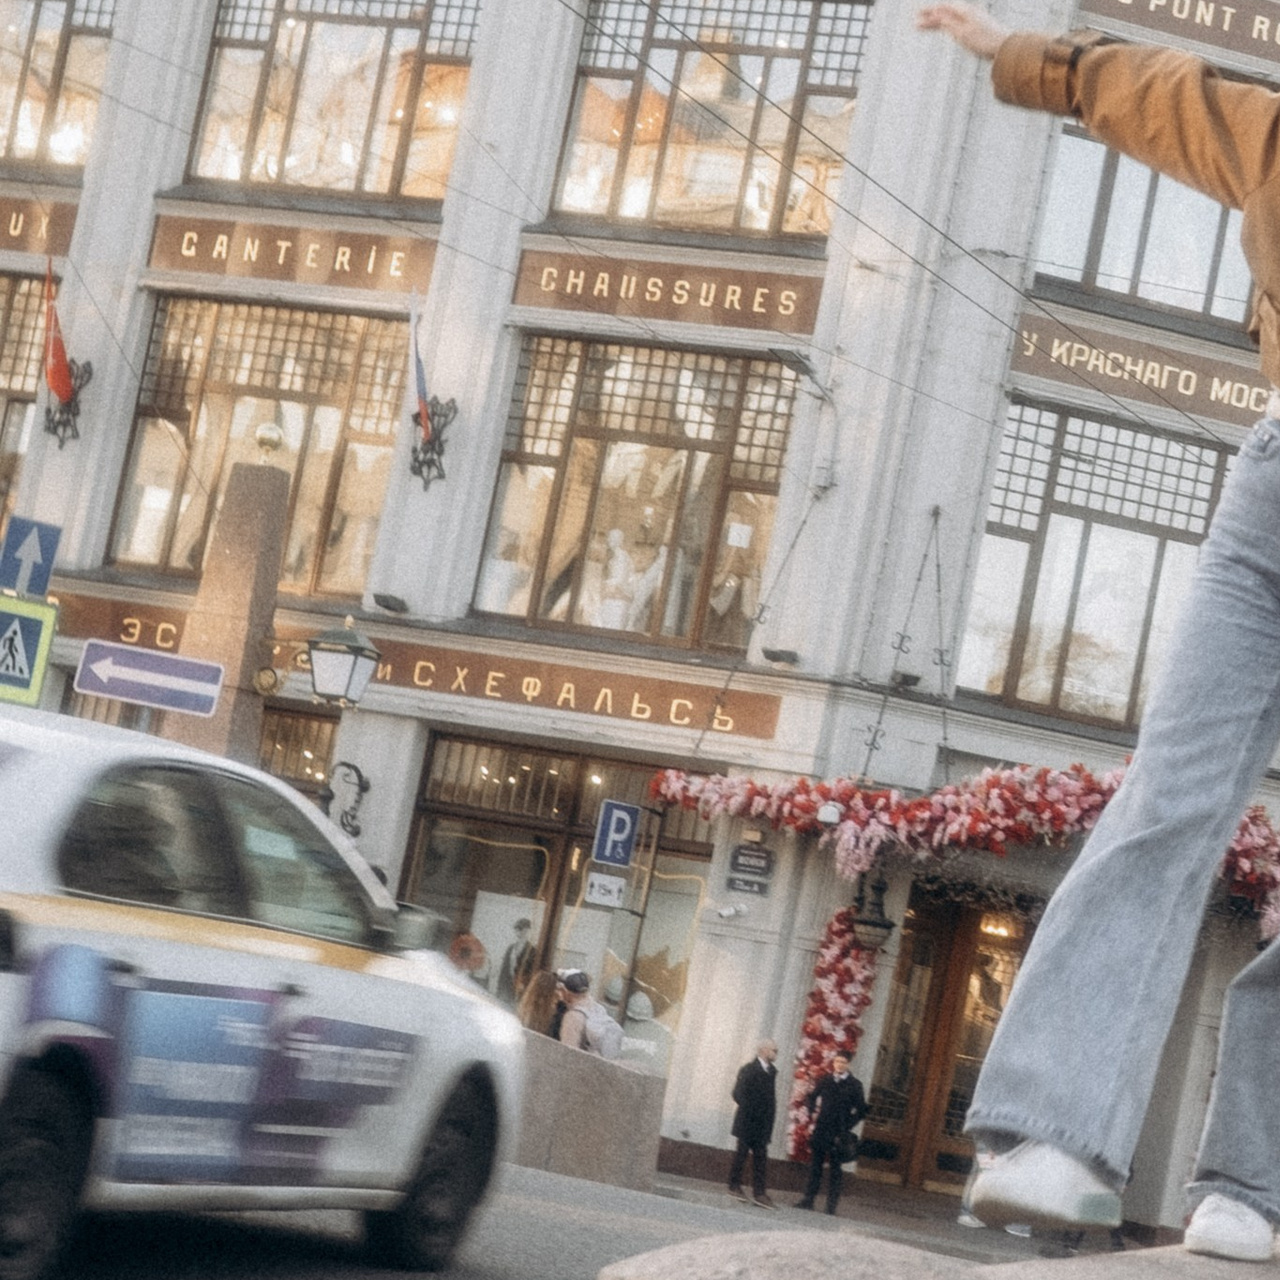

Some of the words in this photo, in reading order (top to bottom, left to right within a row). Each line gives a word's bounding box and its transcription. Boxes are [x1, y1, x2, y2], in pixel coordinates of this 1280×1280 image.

[180, 230, 406, 277] GANTERIE
[539, 266, 798, 316] CHAUSSURES
[1021, 329, 1039, 357] У
[1050, 338, 1197, 396] КРАСНАГО
